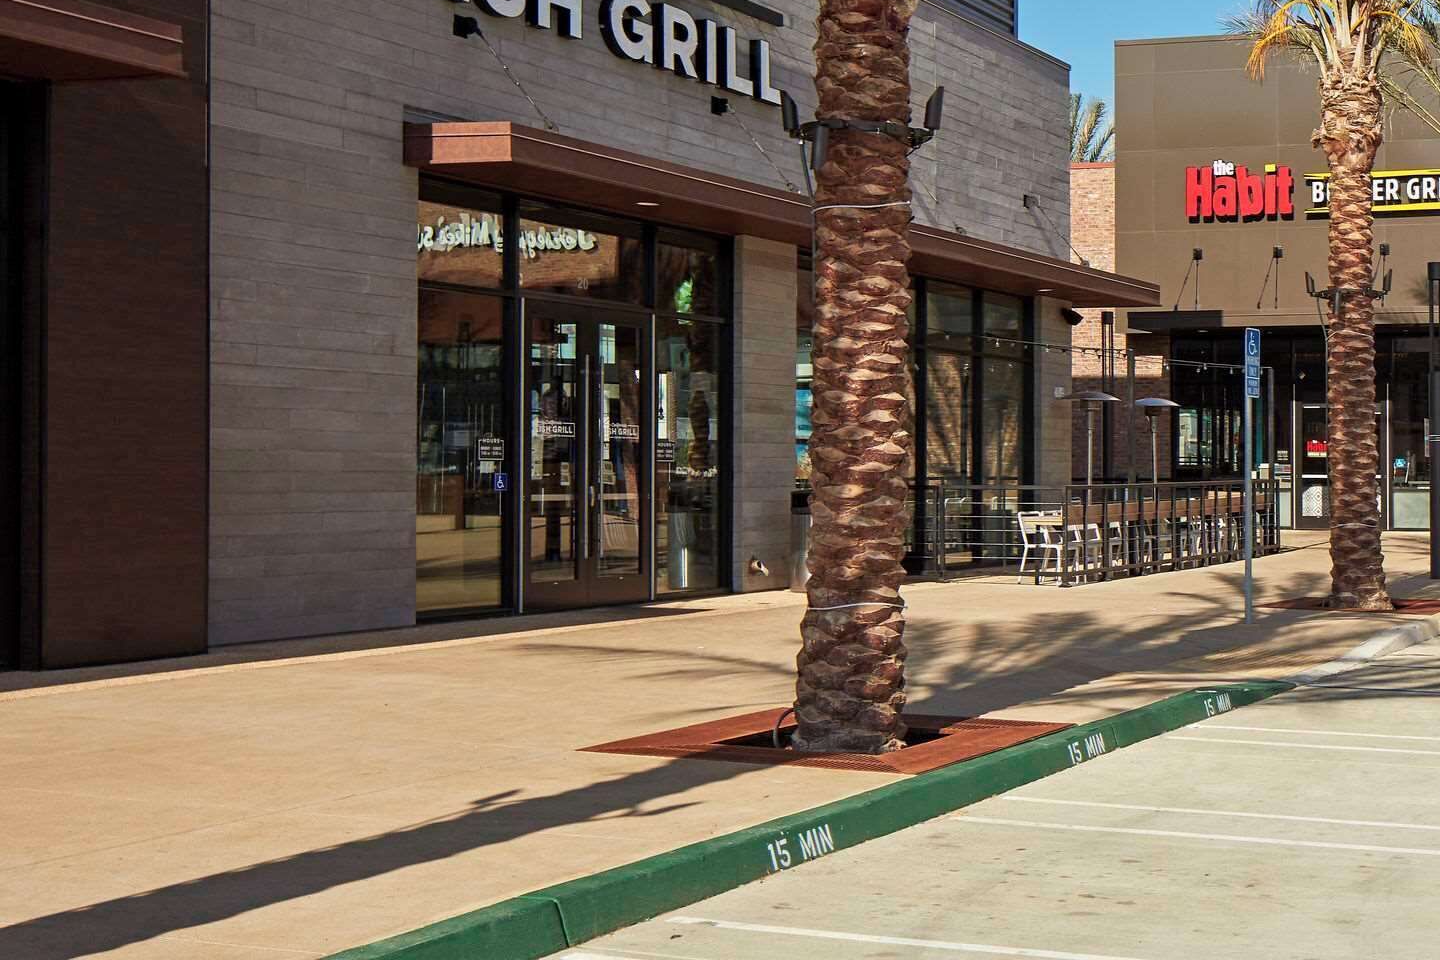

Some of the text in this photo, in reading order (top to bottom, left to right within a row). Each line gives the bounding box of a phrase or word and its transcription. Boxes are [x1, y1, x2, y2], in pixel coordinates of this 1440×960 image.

[1212, 159, 1235, 176] the
[1185, 163, 1294, 217] Habit
[1311, 177, 1399, 203] BER
[576, 278, 589, 290] 20
[552, 425, 574, 434] GRILL
[618, 427, 637, 436] GRILL
[1203, 692, 1232, 717] 15 MIN
[1067, 732, 1106, 765] 15 MIN
[767, 823, 835, 872] 15 MIN
